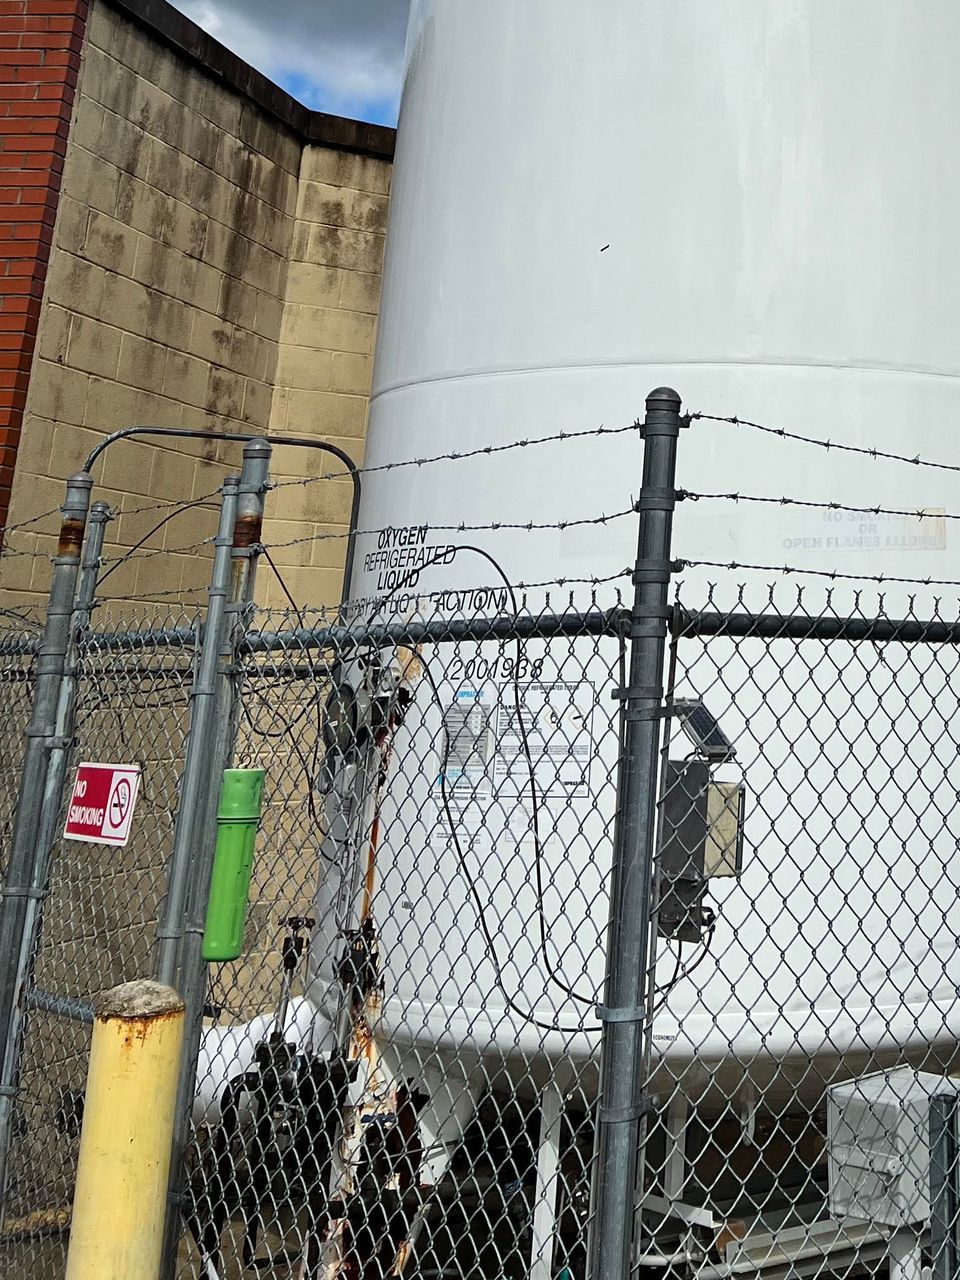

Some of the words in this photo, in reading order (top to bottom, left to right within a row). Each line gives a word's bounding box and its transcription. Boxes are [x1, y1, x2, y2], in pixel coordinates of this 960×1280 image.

[378, 526, 429, 549] OXYGEN
[364, 545, 456, 571] REFRIGERATED
[377, 569, 420, 590] LIQUID
[450, 658, 544, 680] 2001938
[74, 780, 87, 798] NO
[69, 805, 104, 826] SMOKING
